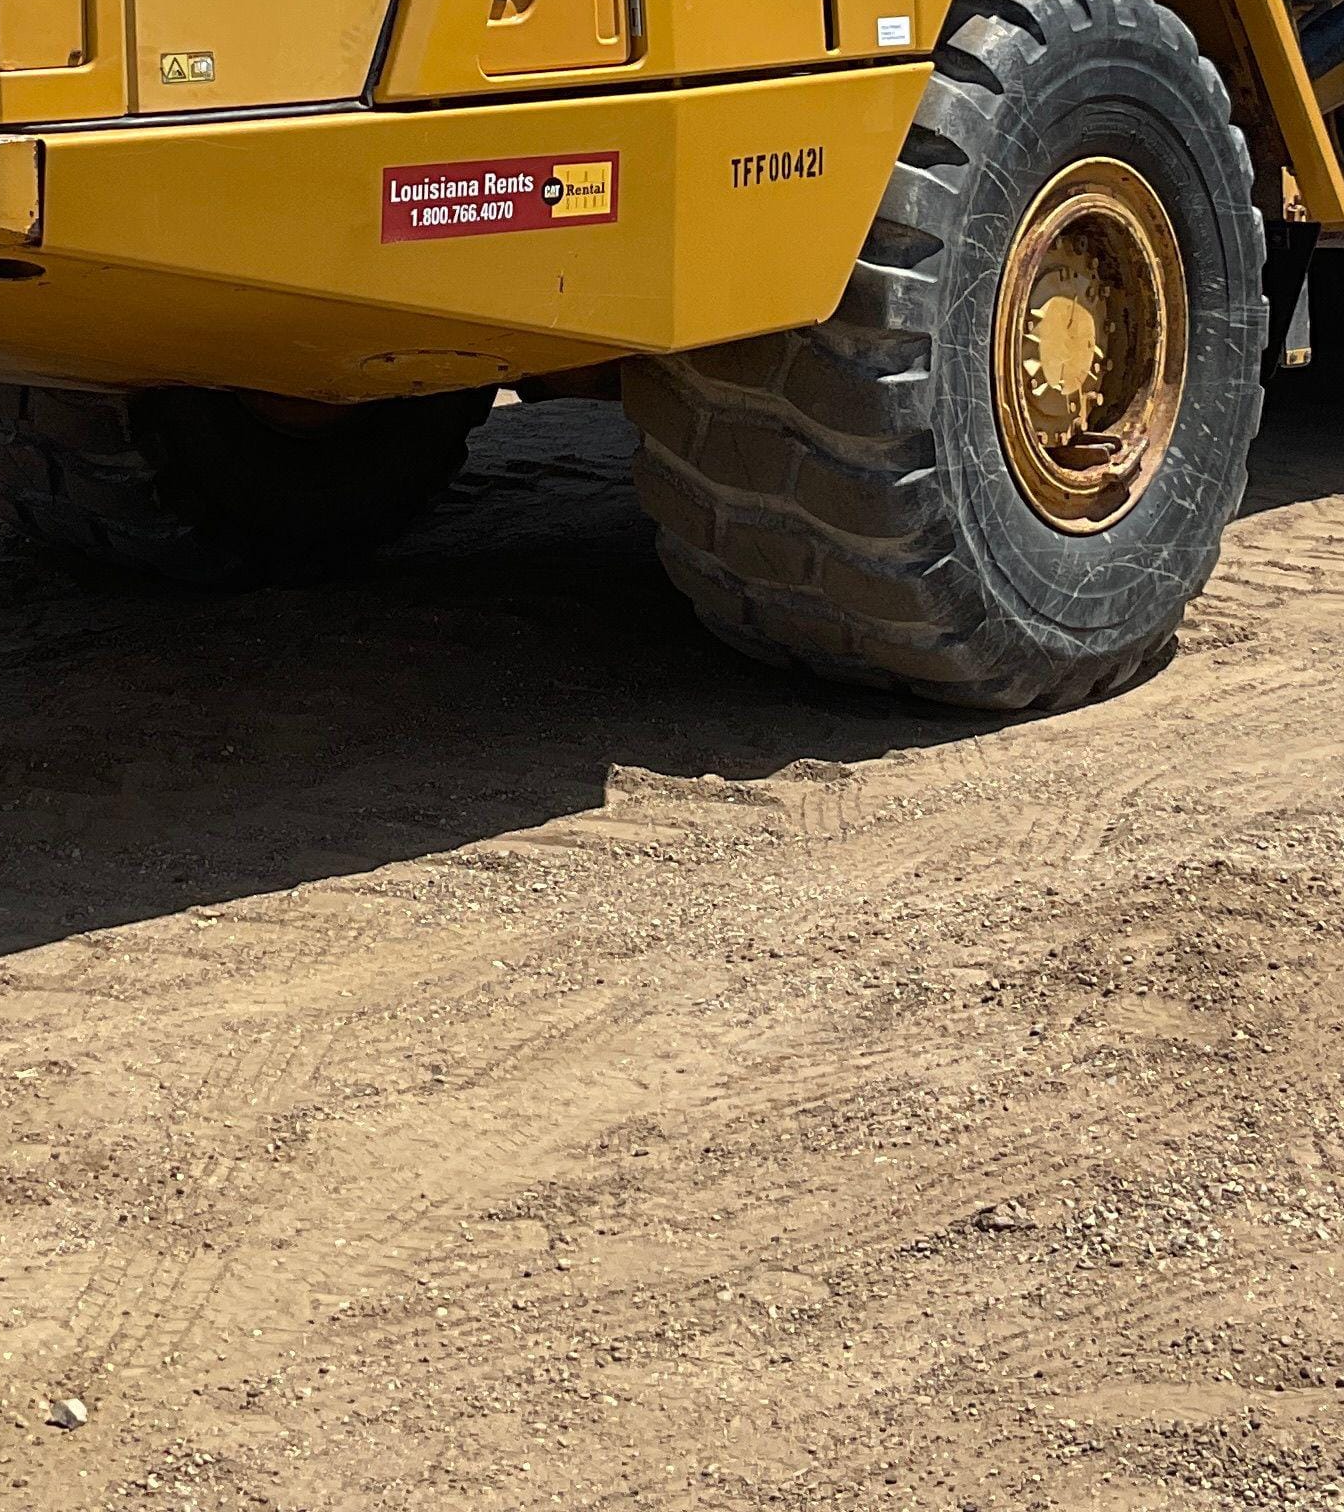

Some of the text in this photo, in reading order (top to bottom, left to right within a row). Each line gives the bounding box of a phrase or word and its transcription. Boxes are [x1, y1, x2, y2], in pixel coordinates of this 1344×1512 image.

[390, 173, 534, 203] Louisiana Rents
[544, 182, 606, 199] CAT Rental
[410, 200, 514, 227] 1.800.766.4070
